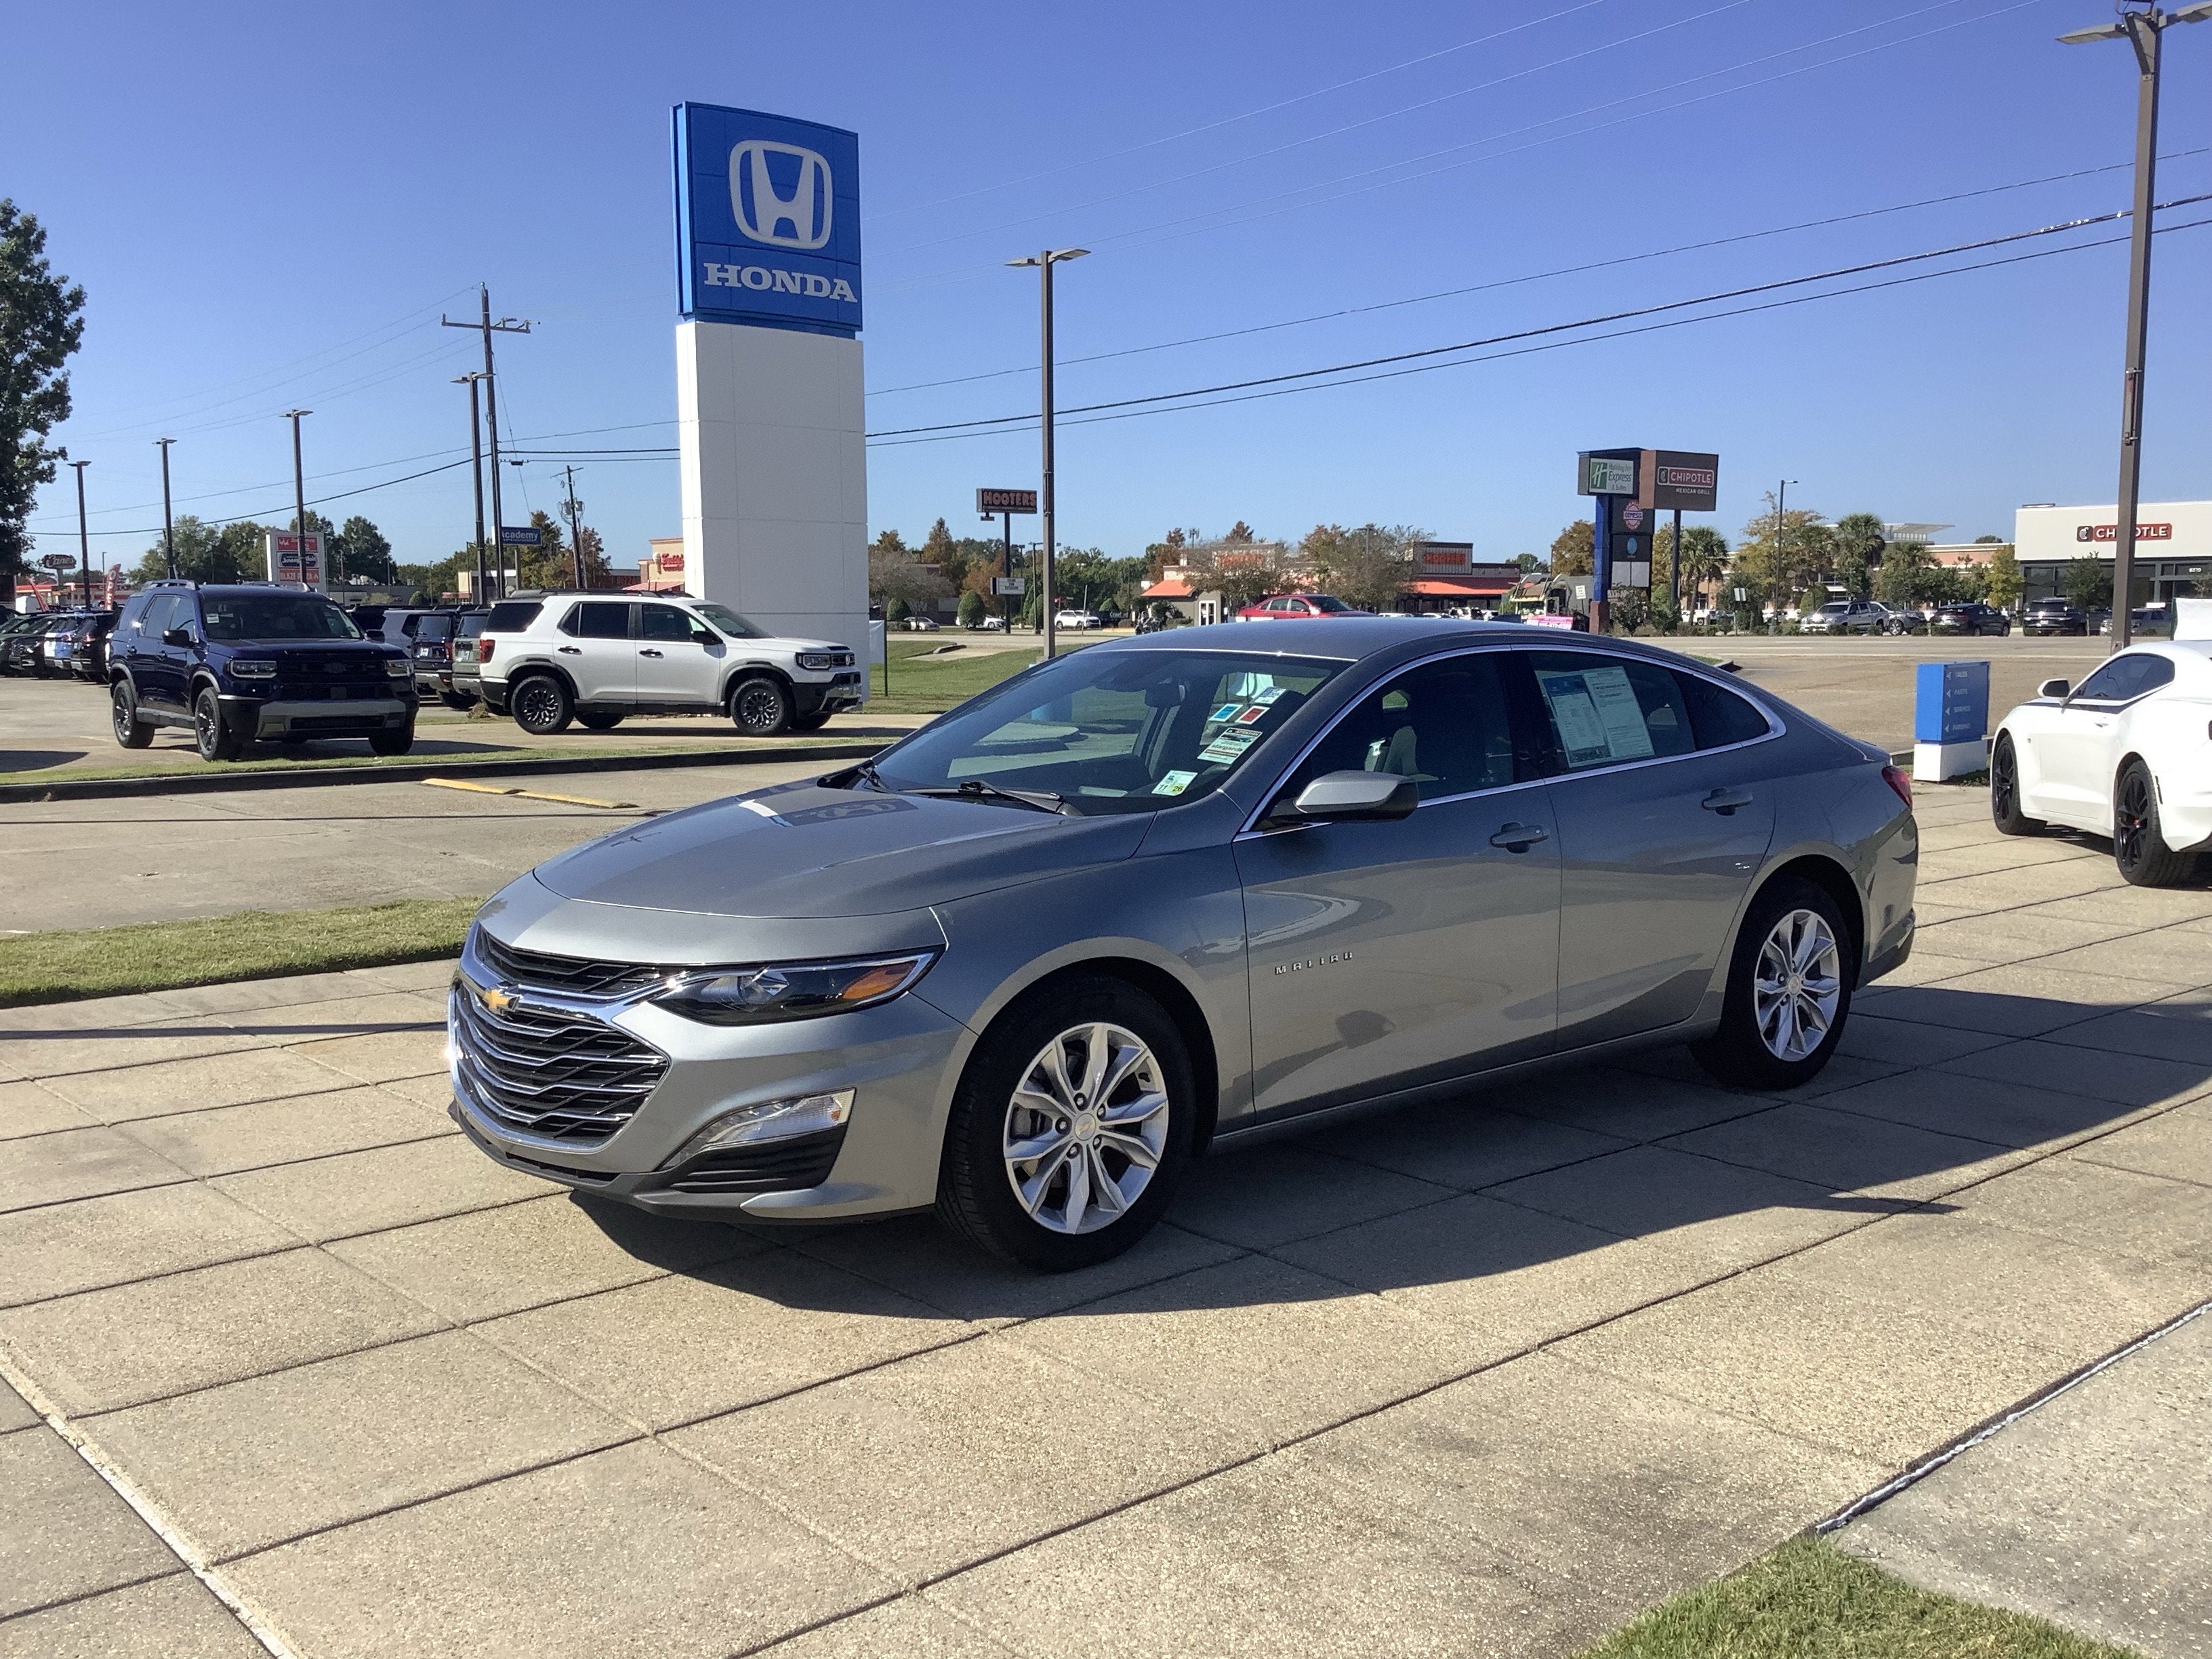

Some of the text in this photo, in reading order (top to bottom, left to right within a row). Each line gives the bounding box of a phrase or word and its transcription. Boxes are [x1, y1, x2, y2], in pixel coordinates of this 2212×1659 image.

[703, 262, 858, 303] HONDA
[1609, 471, 1631, 483] Express
[1671, 472, 1712, 483] CHIPOTLE
[983, 491, 1036, 506] HOOTERS
[2096, 526, 2167, 538] CHOTLE
[1275, 951, 1353, 975] MALIBU
